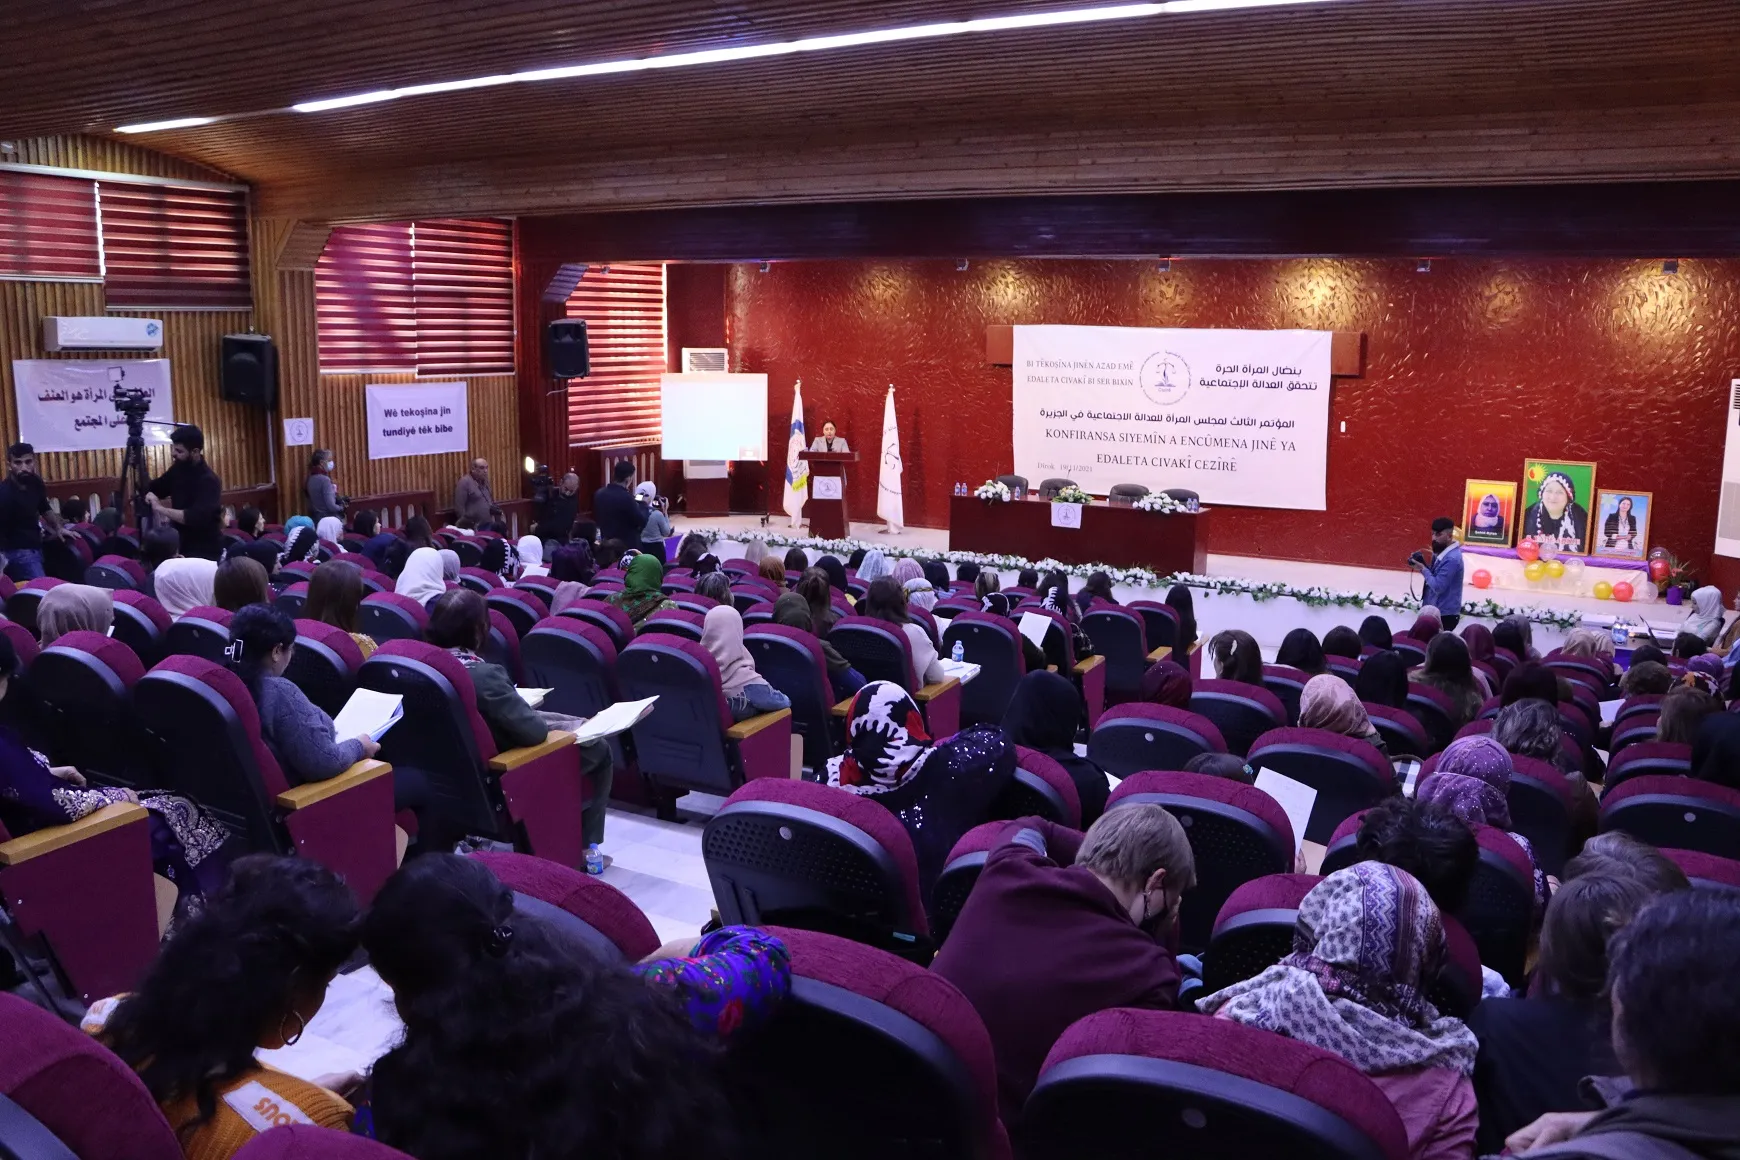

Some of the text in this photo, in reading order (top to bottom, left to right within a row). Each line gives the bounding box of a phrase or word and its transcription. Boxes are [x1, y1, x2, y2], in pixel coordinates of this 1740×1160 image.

[1026, 360, 1034, 368] BI
[1095, 362, 1117, 370] AZAD
[1215, 363, 1302, 377] بنضال المرأة الحرة
[1027, 375, 1060, 384] EDALETA
[1087, 377, 1095, 385] BI
[1251, 379, 1283, 389] العدالة
[1286, 380, 1318, 392] تتحقق
[38, 389, 69, 402] العنف
[70, 391, 83, 404] هو
[84, 386, 107, 403] المرأة
[440, 406, 451, 417] jin
[1039, 408, 1068, 419] الجزيرة
[1070, 410, 1084, 421] في
[1134, 412, 1163, 422] للعدالة
[74, 414, 108, 432] المجتمع
[1165, 413, 1191, 425] المرأة
[1193, 416, 1227, 427] لمجلس
[1230, 416, 1257, 427] الثالث
[1259, 419, 1295, 430] المؤتمر
[435, 424, 453, 433] bibe
[1045, 428, 1296, 452] KONFIRANSA SIYEMÎN A ENCÛMENA JINÊ YA
[1096, 453, 1238, 472] EDALETA CIVAKÎ CEZÎRÊ
[253, 1096, 299, 1128] OUS
